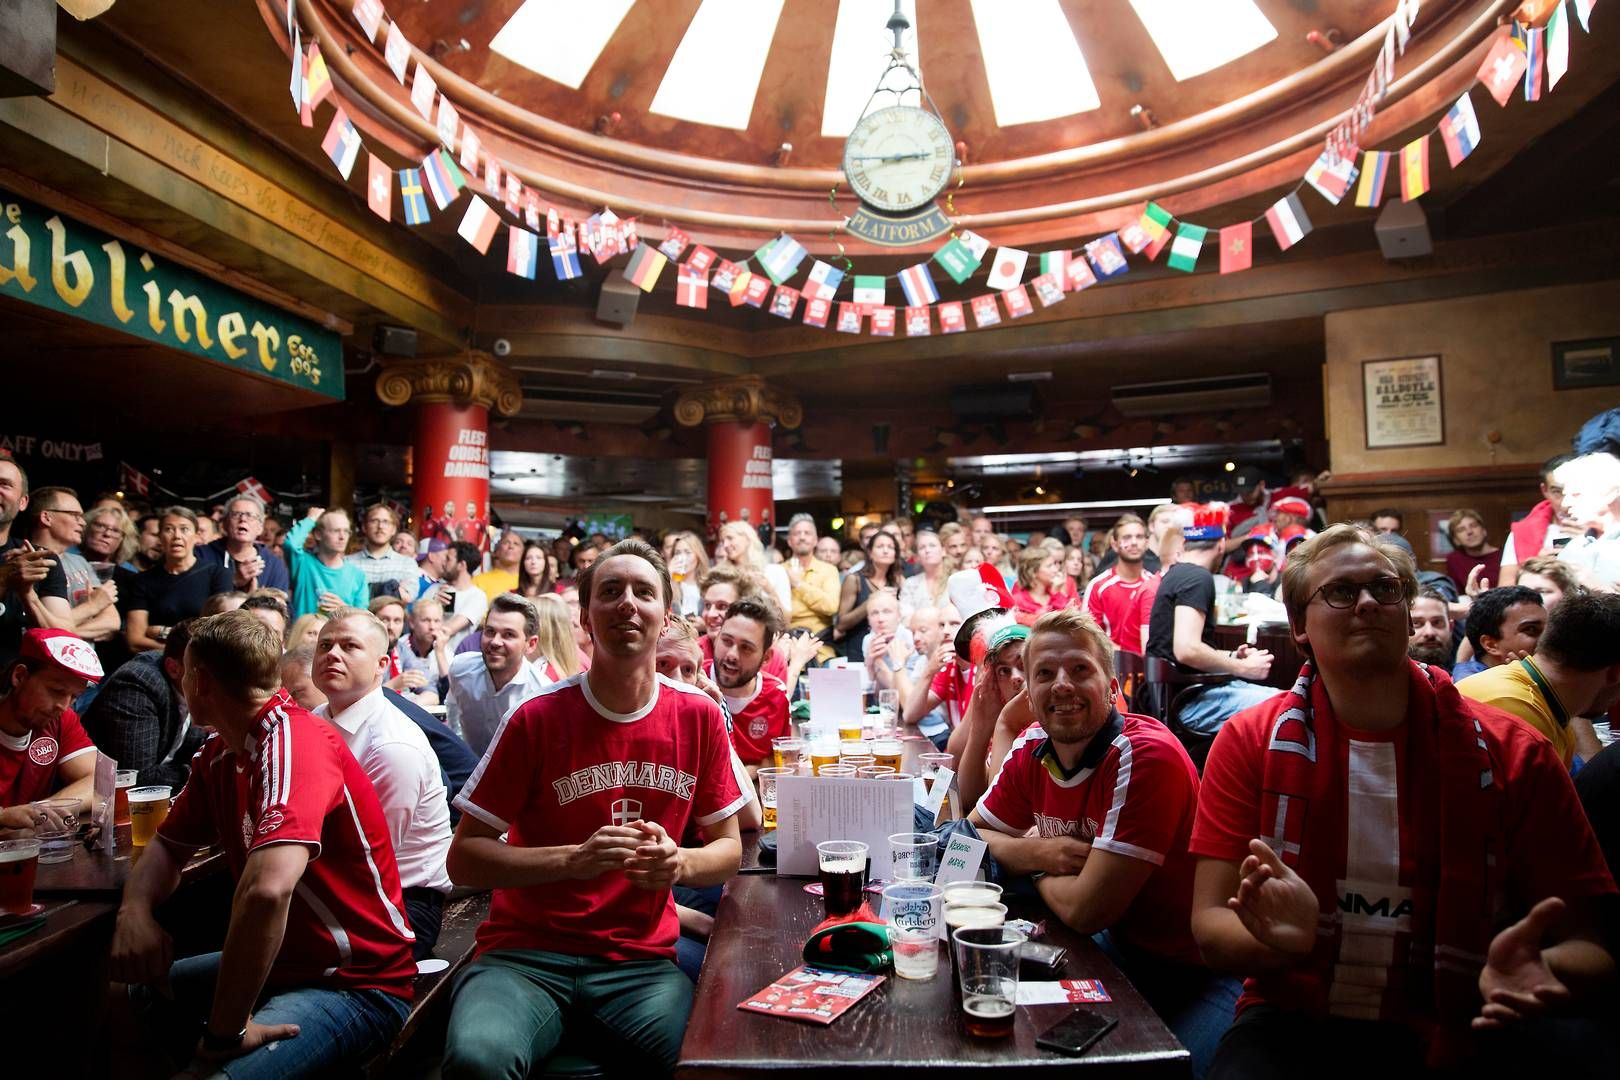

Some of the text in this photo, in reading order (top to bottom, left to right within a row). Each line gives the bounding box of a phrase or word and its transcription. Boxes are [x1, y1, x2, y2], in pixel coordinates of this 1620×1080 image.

[849, 213, 936, 241] PLATFORM
[0, 434, 37, 456] AFF
[552, 761, 697, 806] DENMARK
[1336, 892, 1413, 919] NMA
[895, 911, 936, 932] Carlsberg
